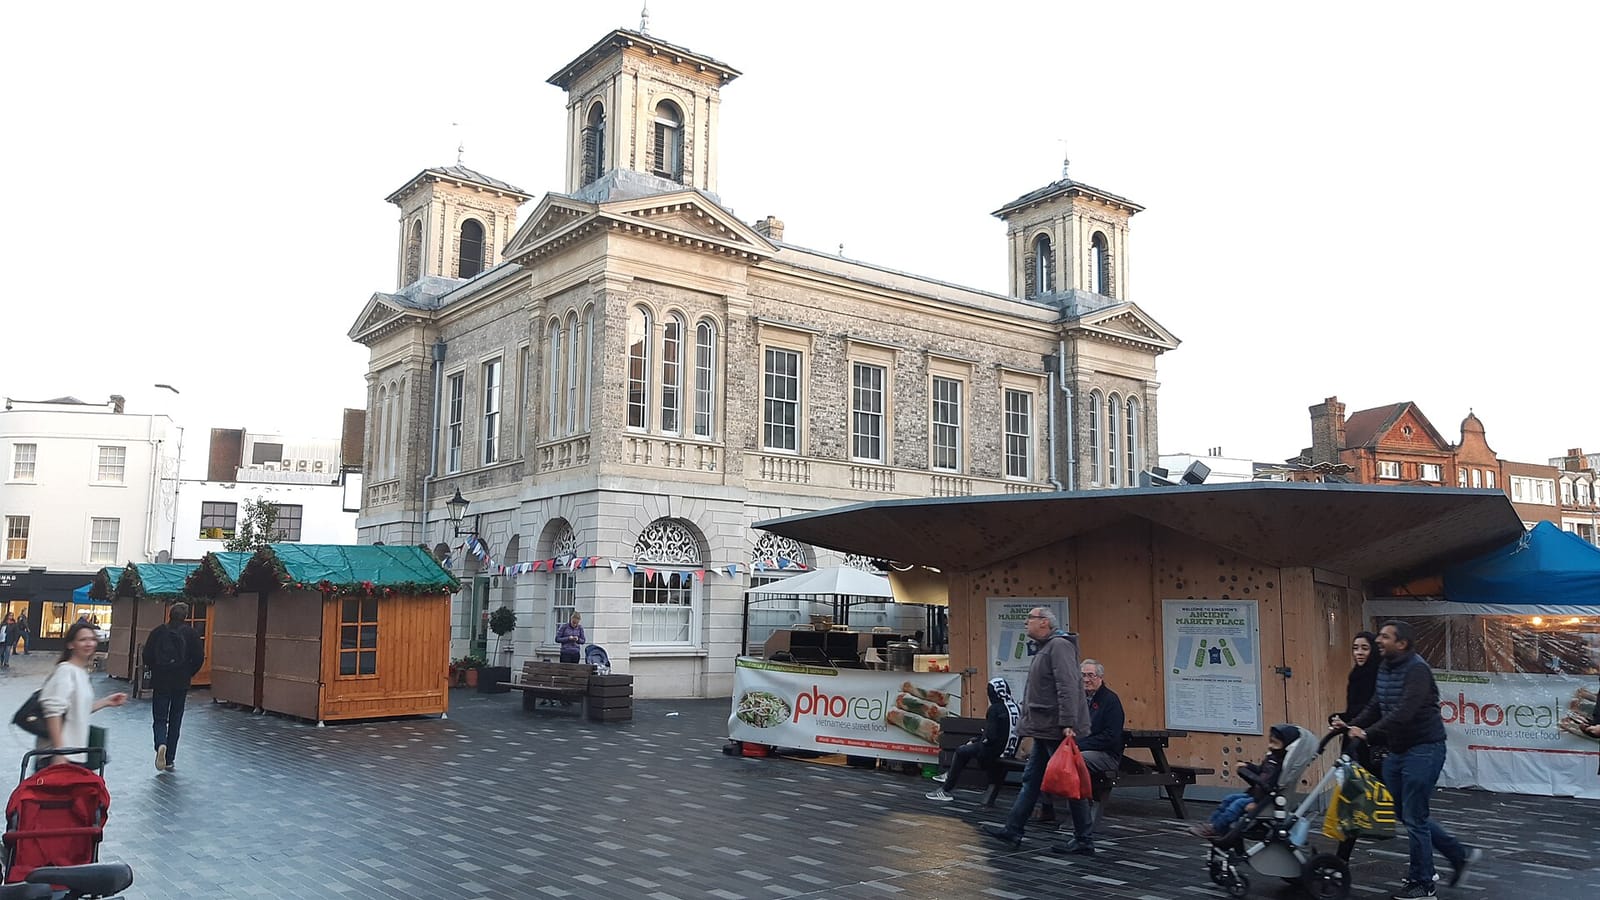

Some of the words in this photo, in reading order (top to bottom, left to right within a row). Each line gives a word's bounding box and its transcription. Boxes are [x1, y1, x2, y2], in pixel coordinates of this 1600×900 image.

[792, 685, 889, 723] phoreal
[816, 720, 851, 729] vietnamese
[852, 722, 870, 731] street
[871, 722, 888, 732] food
[1464, 727, 1513, 738] vietnamese
[1540, 730, 1560, 740] food
